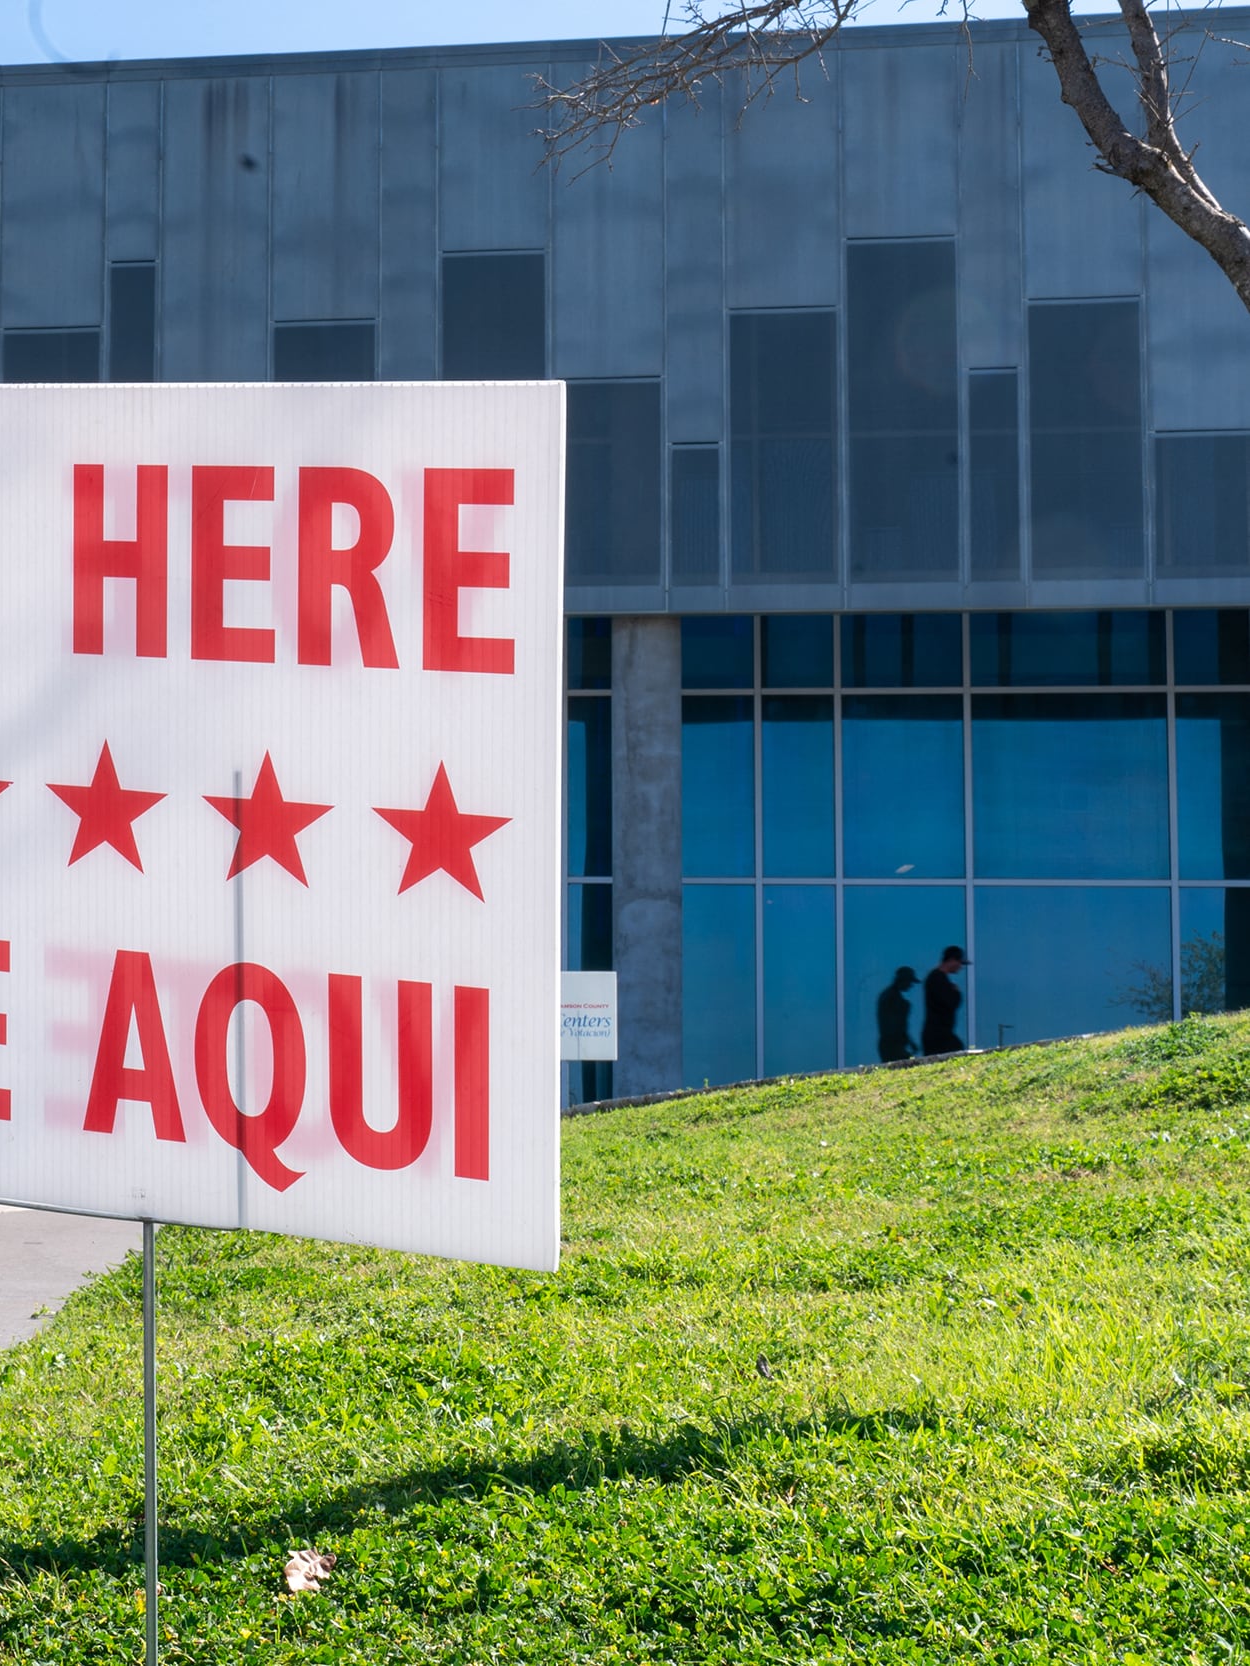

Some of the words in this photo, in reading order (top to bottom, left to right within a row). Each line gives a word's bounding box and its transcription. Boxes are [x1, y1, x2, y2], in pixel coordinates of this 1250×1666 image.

[73, 463, 515, 674] HERE
[83, 950, 489, 1192] AQUI
[561, 1014, 611, 1027] enters
